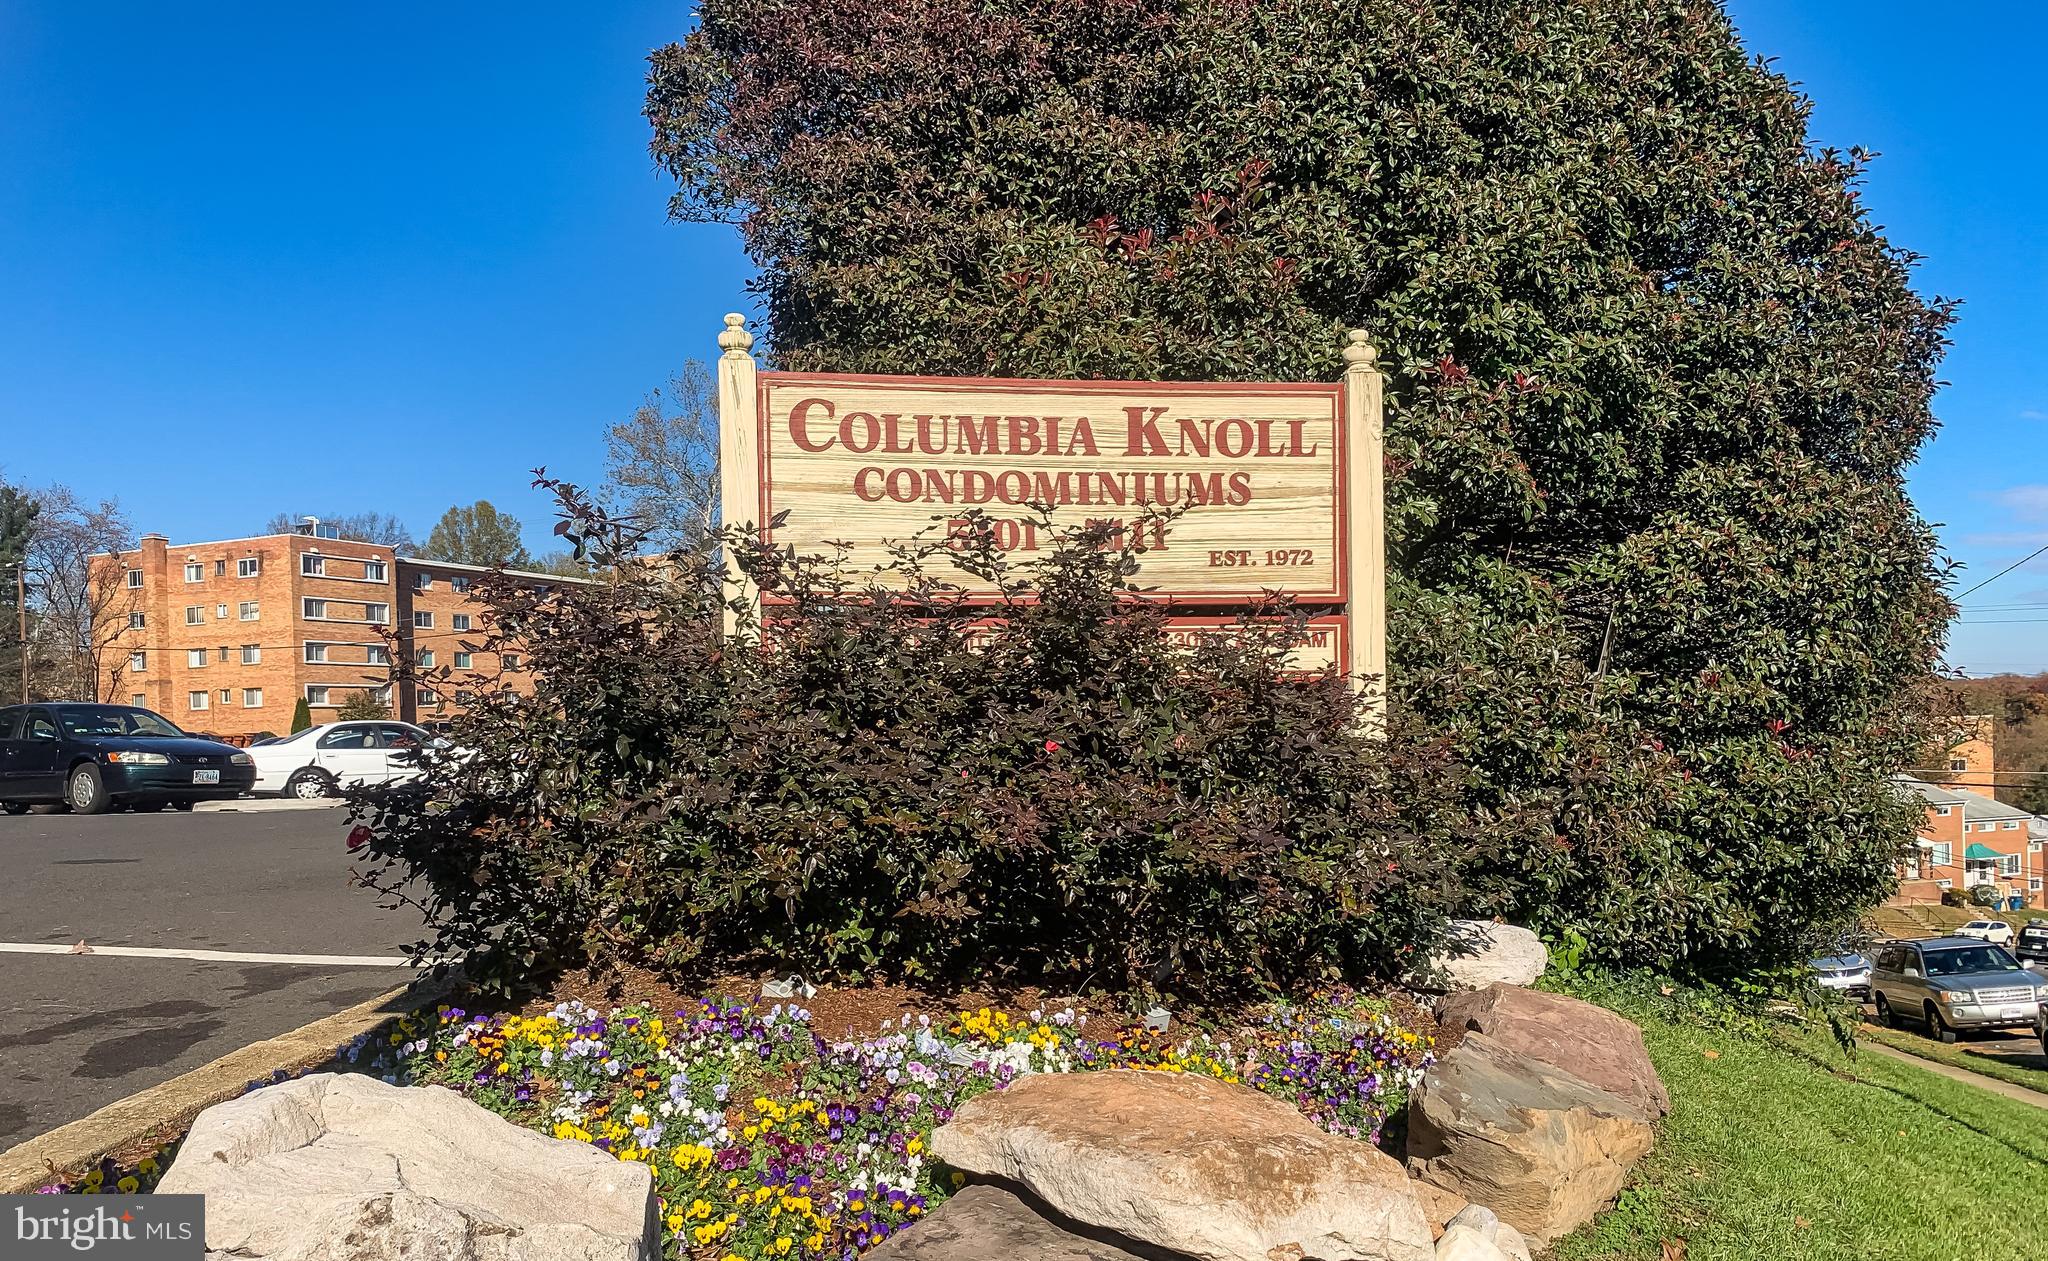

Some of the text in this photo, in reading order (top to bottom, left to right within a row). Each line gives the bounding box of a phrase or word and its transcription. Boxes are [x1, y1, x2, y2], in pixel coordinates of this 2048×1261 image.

[788, 397, 1318, 458] COLUMBIA KNOLL
[853, 466, 1252, 507] CONDOMINIUMS
[1208, 549, 1314, 567] EST. 1972
